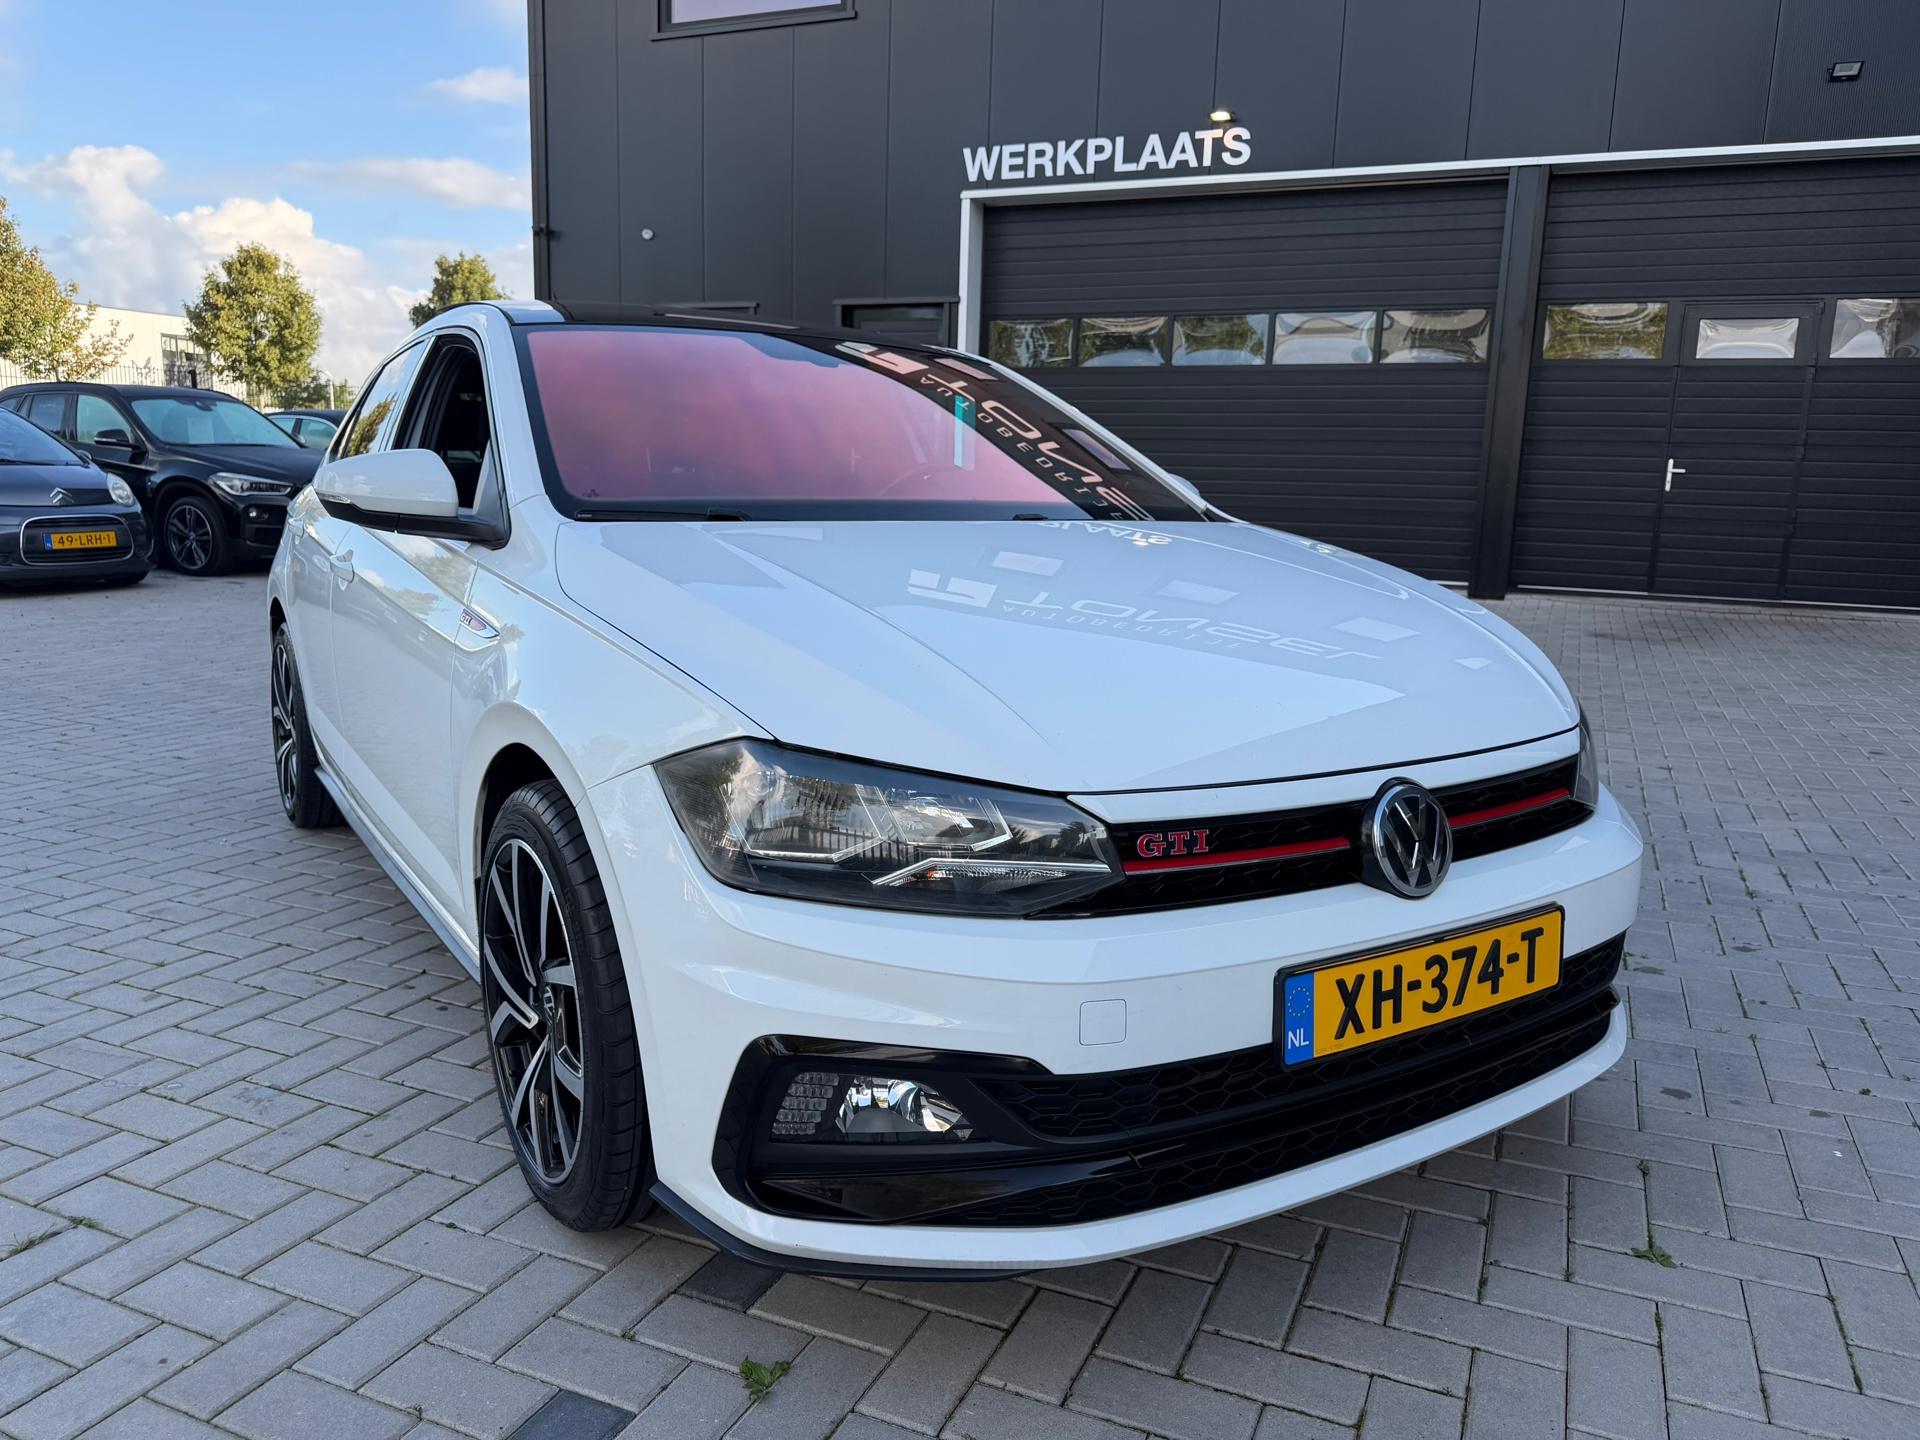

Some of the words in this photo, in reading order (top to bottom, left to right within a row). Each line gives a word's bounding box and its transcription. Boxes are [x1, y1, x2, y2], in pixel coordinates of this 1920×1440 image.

[962, 126, 1252, 183] WERKPLAATS
[58, 534, 111, 547] 49-LRH-1
[1136, 829, 1210, 858] GTI
[1334, 926, 1545, 1040] XH-374-T
[1287, 1027, 1310, 1050] NL
